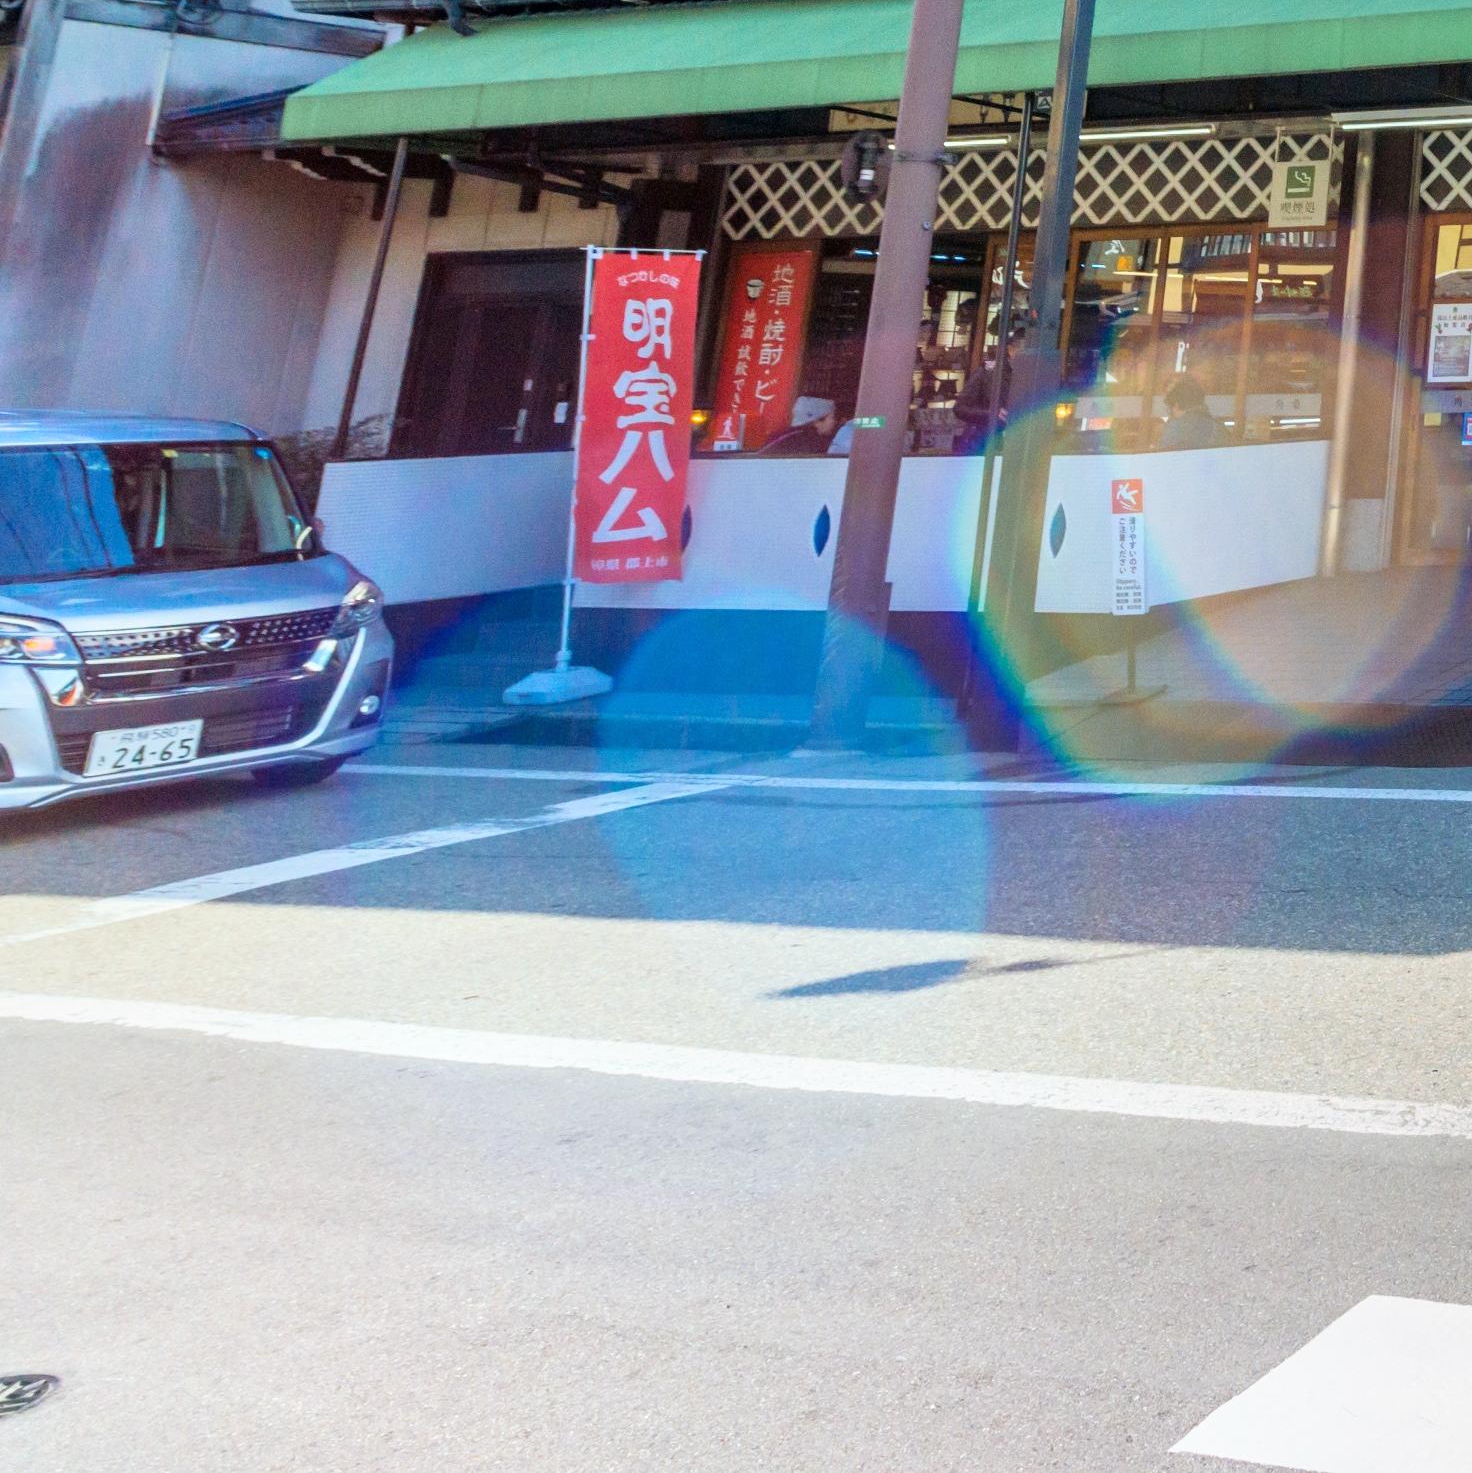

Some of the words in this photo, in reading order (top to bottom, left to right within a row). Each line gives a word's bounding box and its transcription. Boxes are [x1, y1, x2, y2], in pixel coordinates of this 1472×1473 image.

[592, 297, 678, 544] 明宝ハム
[112, 738, 194, 768] 24-65
